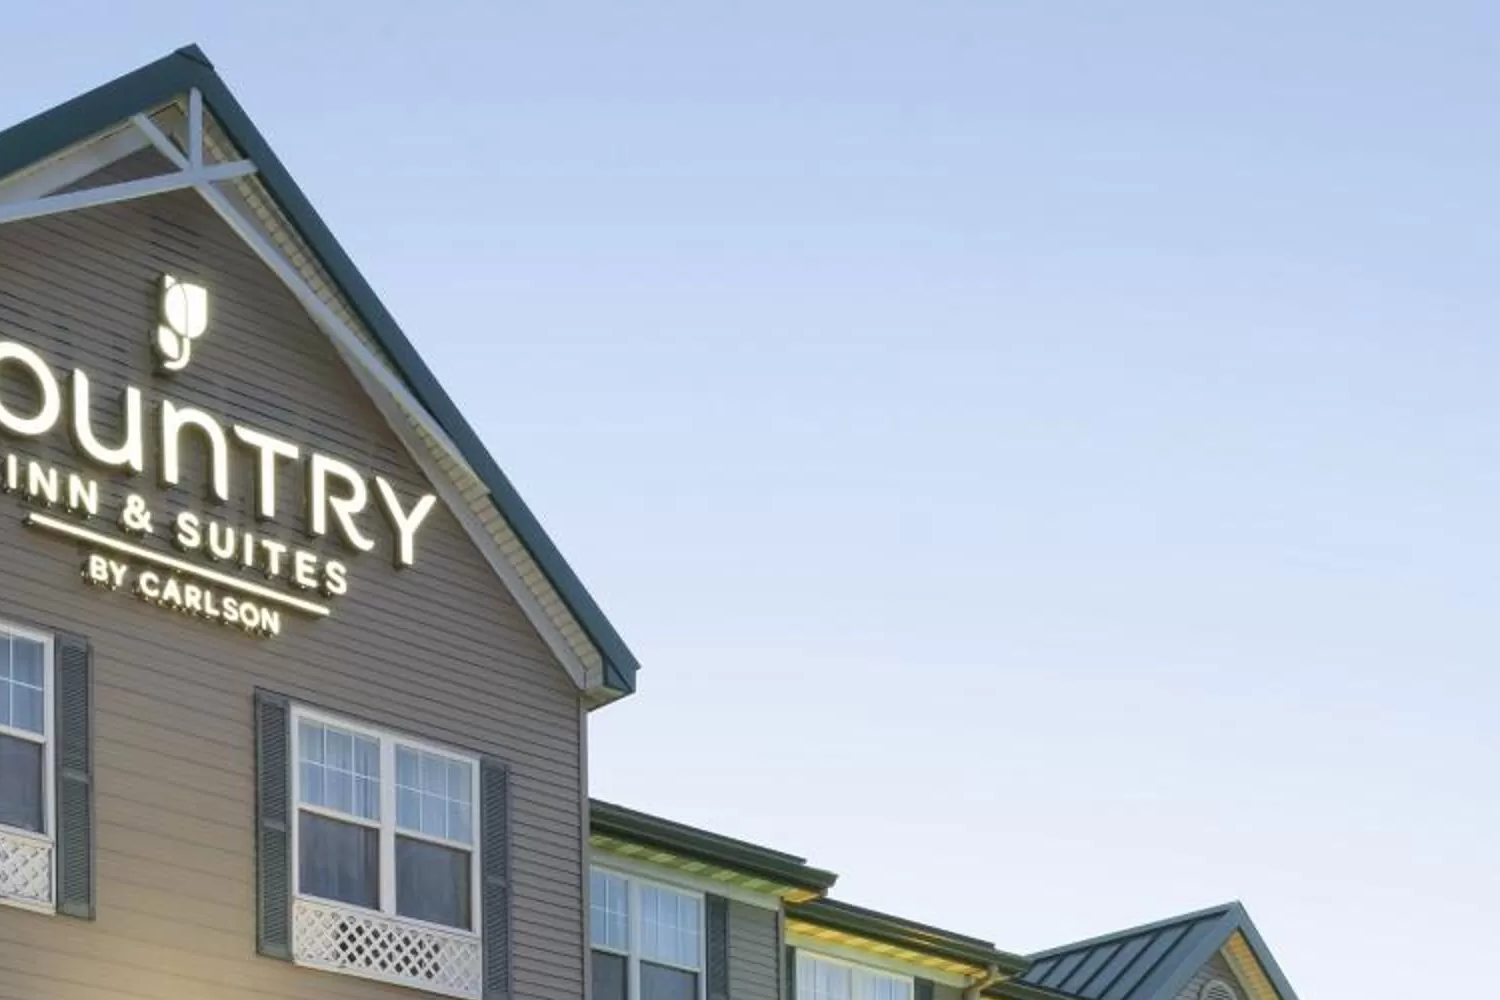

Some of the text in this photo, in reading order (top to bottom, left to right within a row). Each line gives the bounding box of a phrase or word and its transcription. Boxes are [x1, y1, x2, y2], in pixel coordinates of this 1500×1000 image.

[6, 453, 348, 596] INN & SUITES
[88, 554, 281, 636] BY CARLSON
